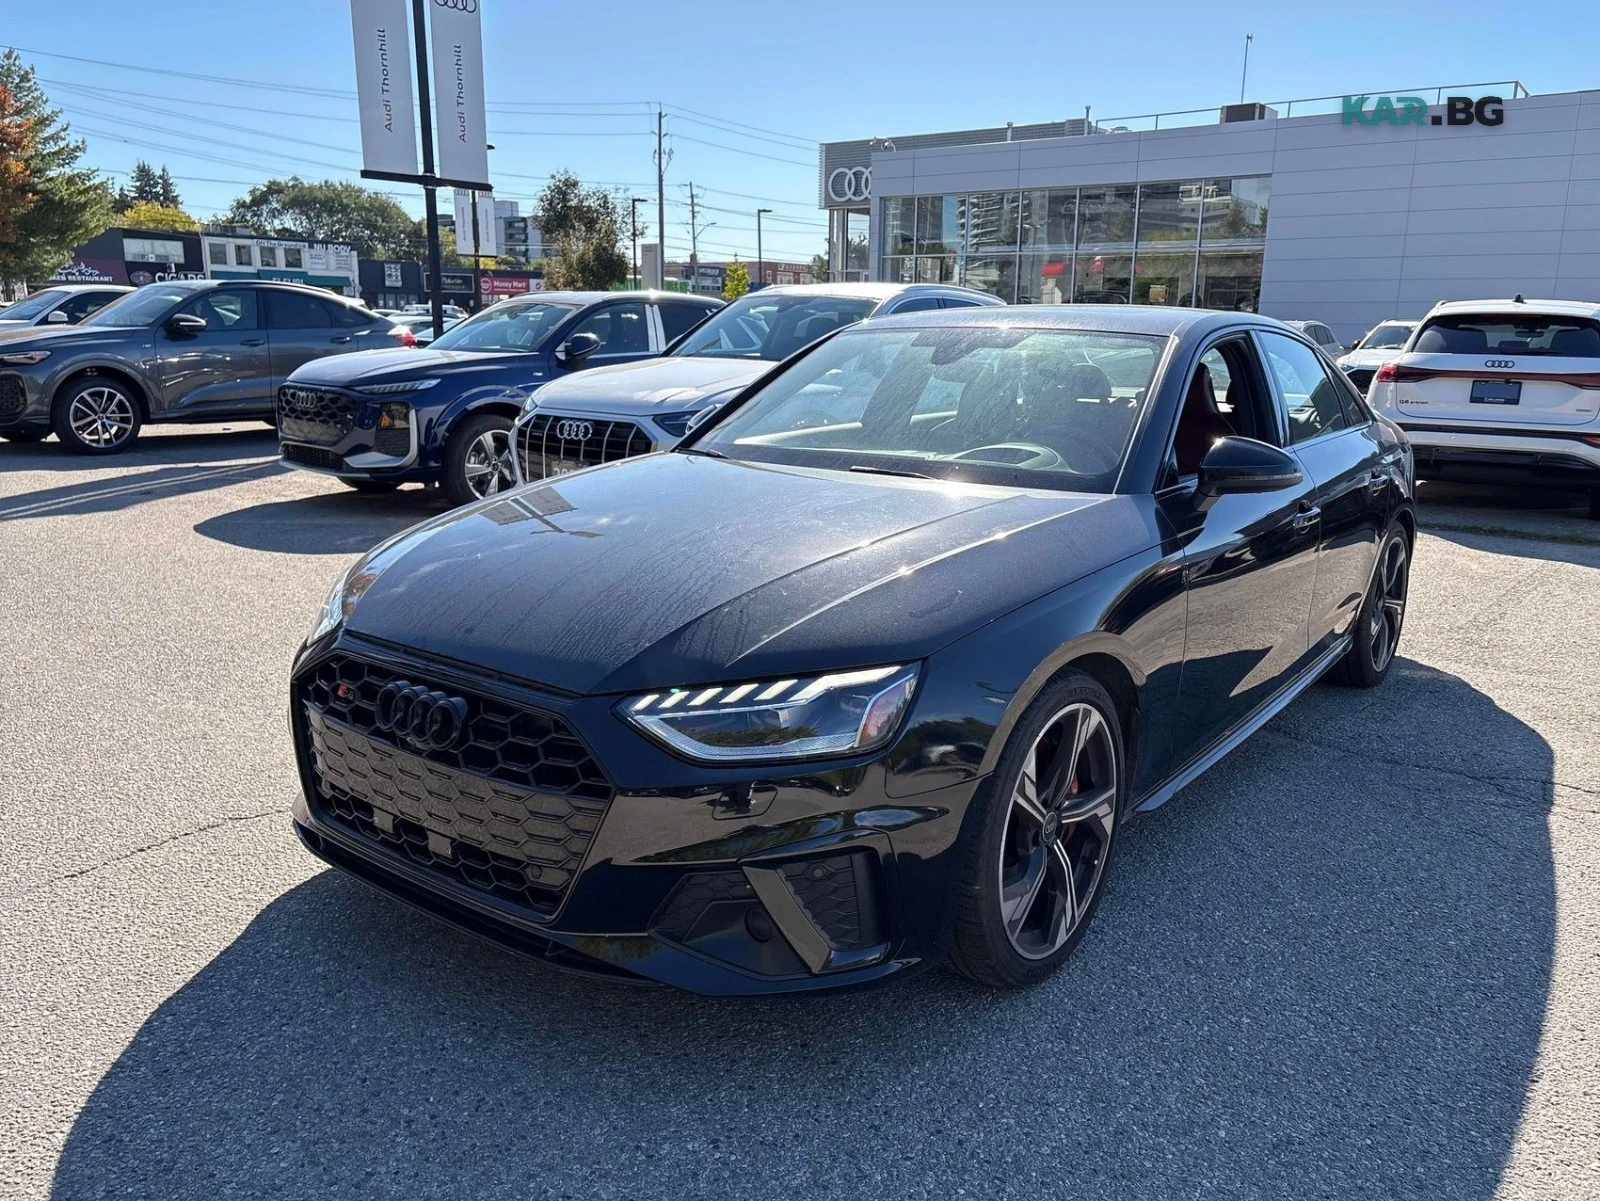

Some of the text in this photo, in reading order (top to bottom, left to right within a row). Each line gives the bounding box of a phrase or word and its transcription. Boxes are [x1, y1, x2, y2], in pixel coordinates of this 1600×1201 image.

[377, 28, 393, 133] Audi Thornhill
[453, 44, 467, 143] Audi Thornhill
[314, 243, 351, 253] NU BODY
